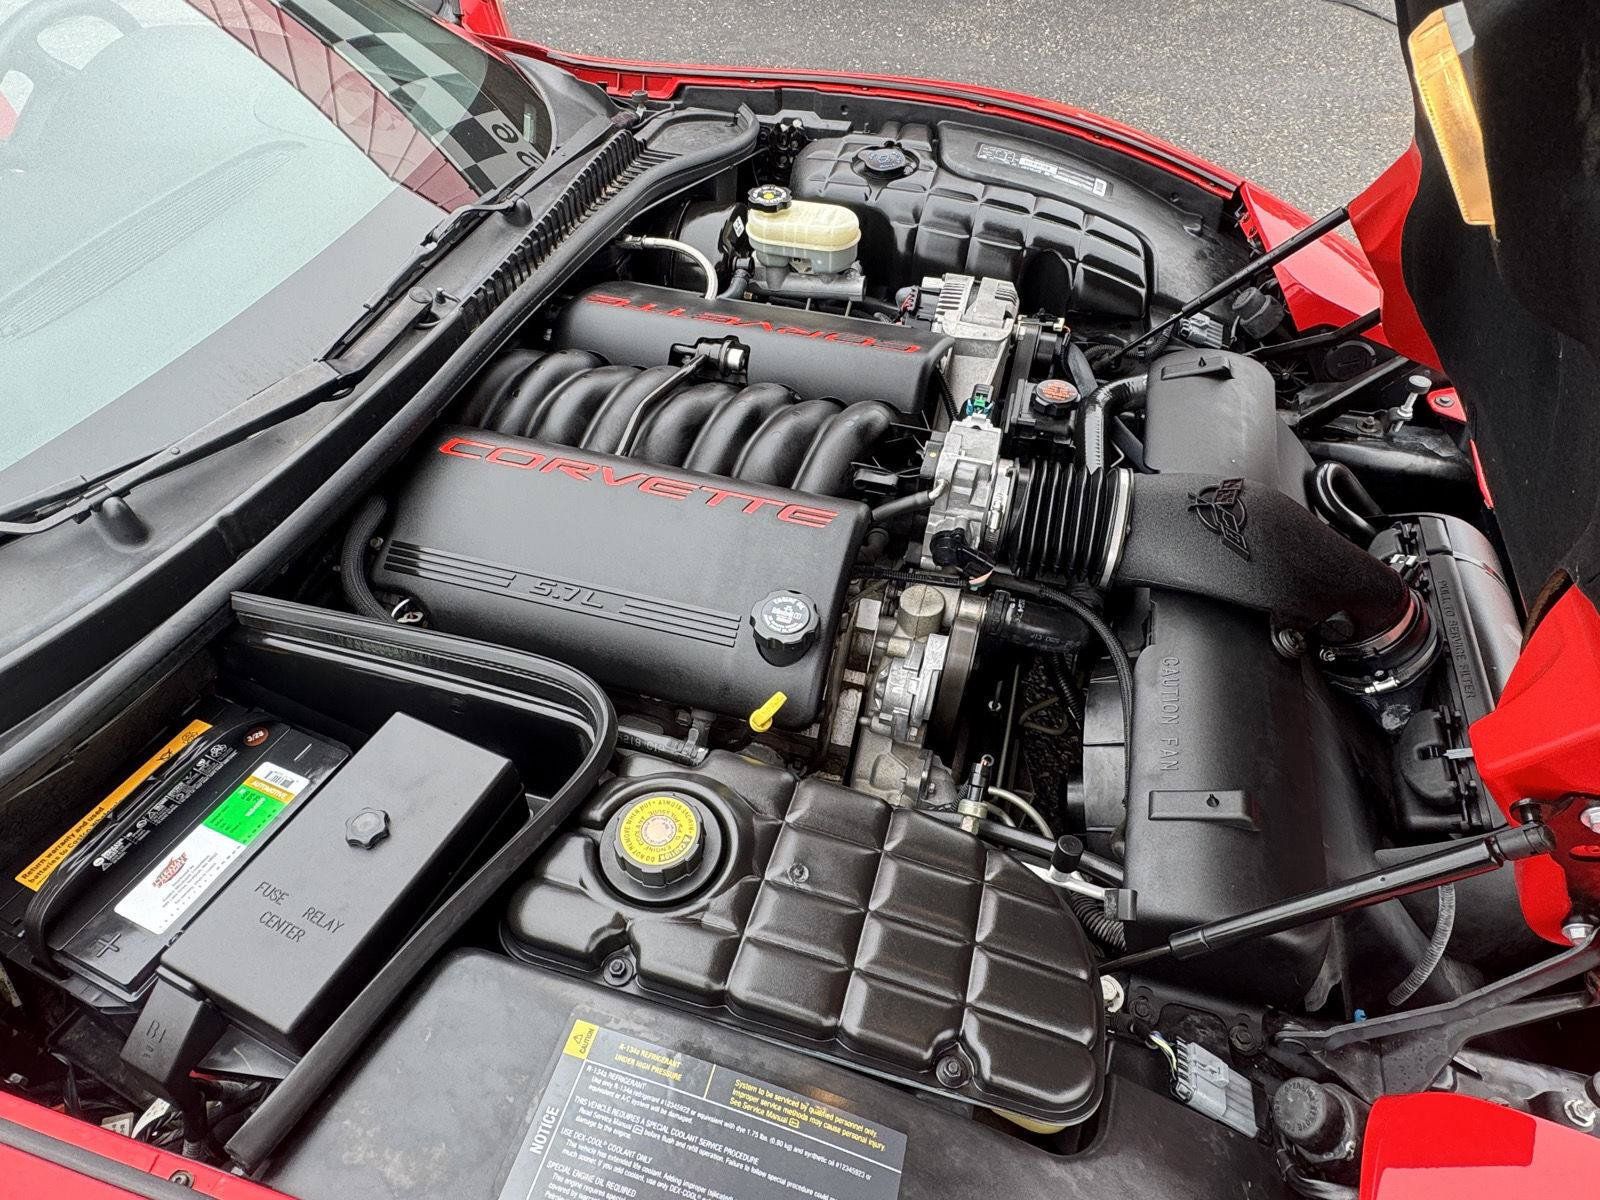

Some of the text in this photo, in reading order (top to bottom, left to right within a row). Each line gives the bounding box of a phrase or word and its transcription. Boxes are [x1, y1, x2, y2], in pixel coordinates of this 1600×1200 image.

[438, 436, 839, 529] CORVETTE
[529, 581, 604, 609] 5.7L
[1448, 618, 1467, 660] SERVICE
[1459, 663, 1476, 699] FILTER
[1161, 656, 1180, 771] CAUTION FAN
[21, 858, 46, 880] Return
[45, 832, 76, 858] warranty
[75, 821, 88, 832] and
[88, 806, 105, 821] used
[28, 856, 60, 883] batteries
[58, 849, 69, 858] to
[254, 881, 345, 935] FUSE RELAY
[259, 911, 306, 943] CENTER
[579, 1028, 594, 1053] CAUTION
[618, 1042, 681, 1069] R-134a REFRIGERANT
[586, 1064, 646, 1090] R-134a REFRIGERANT
[590, 1075, 602, 1084] Use
[600, 1079, 613, 1089] only
[614, 1052, 683, 1082] UNDER HIGH PRESSURE
[574, 1115, 597, 1128] damage
[596, 1122, 604, 1130] to
[602, 1124, 613, 1133] the
[729, 1097, 789, 1124] See Service Manual
[731, 1088, 887, 1152] Improper service methods may cause personal injury.
[733, 1079, 758, 1094] System
[764, 1090, 774, 1098] be
[773, 1093, 800, 1108] serviced
[798, 1102, 809, 1112] by
[807, 1105, 834, 1121] qualified
[833, 1115, 864, 1132] personnel
[862, 1127, 878, 1138] only.
[528, 1104, 560, 1155] NOTICE
[560, 1127, 573, 1136] USE
[606, 1142, 636, 1159] COOLANT
[635, 1152, 652, 1164] ONLY
[573, 1095, 760, 1165] THIS VEHICLE REQUIRES A SPECIAL COOLANT SERVICE PROCEDURE
[561, 1147, 578, 1158] much
[601, 1162, 614, 1172] you
[613, 1165, 625, 1174] add
[645, 1177, 657, 1186] use
[655, 1180, 669, 1191] only
[565, 1138, 578, 1148] This
[576, 1142, 597, 1155] vehicle
[595, 1149, 607, 1158] has
[606, 1153, 633, 1167] extended
[632, 1161, 642, 1170] life
[662, 1172, 683, 1186] Adding
[681, 1180, 707, 1195] improper
[578, 1107, 592, 1117] Read
[591, 1111, 613, 1124] Service
[612, 1118, 632, 1130] Manual
[642, 1128, 662, 1140] before
[660, 1134, 676, 1145] flush
[674, 1139, 686, 1149] and
[685, 1143, 699, 1153] refill
[724, 1157, 744, 1169] Failure
[749, 1166, 767, 1178] follow
[766, 1172, 787, 1186] special
[785, 1179, 814, 1196] procedure
[546, 1159, 572, 1175] SPECIAL
[571, 1168, 595, 1182] ENGINE
[594, 1176, 606, 1186] OIL
[605, 1180, 637, 1197] REQUIRED
[551, 1173, 564, 1182] This
[562, 1177, 583, 1190] engine
